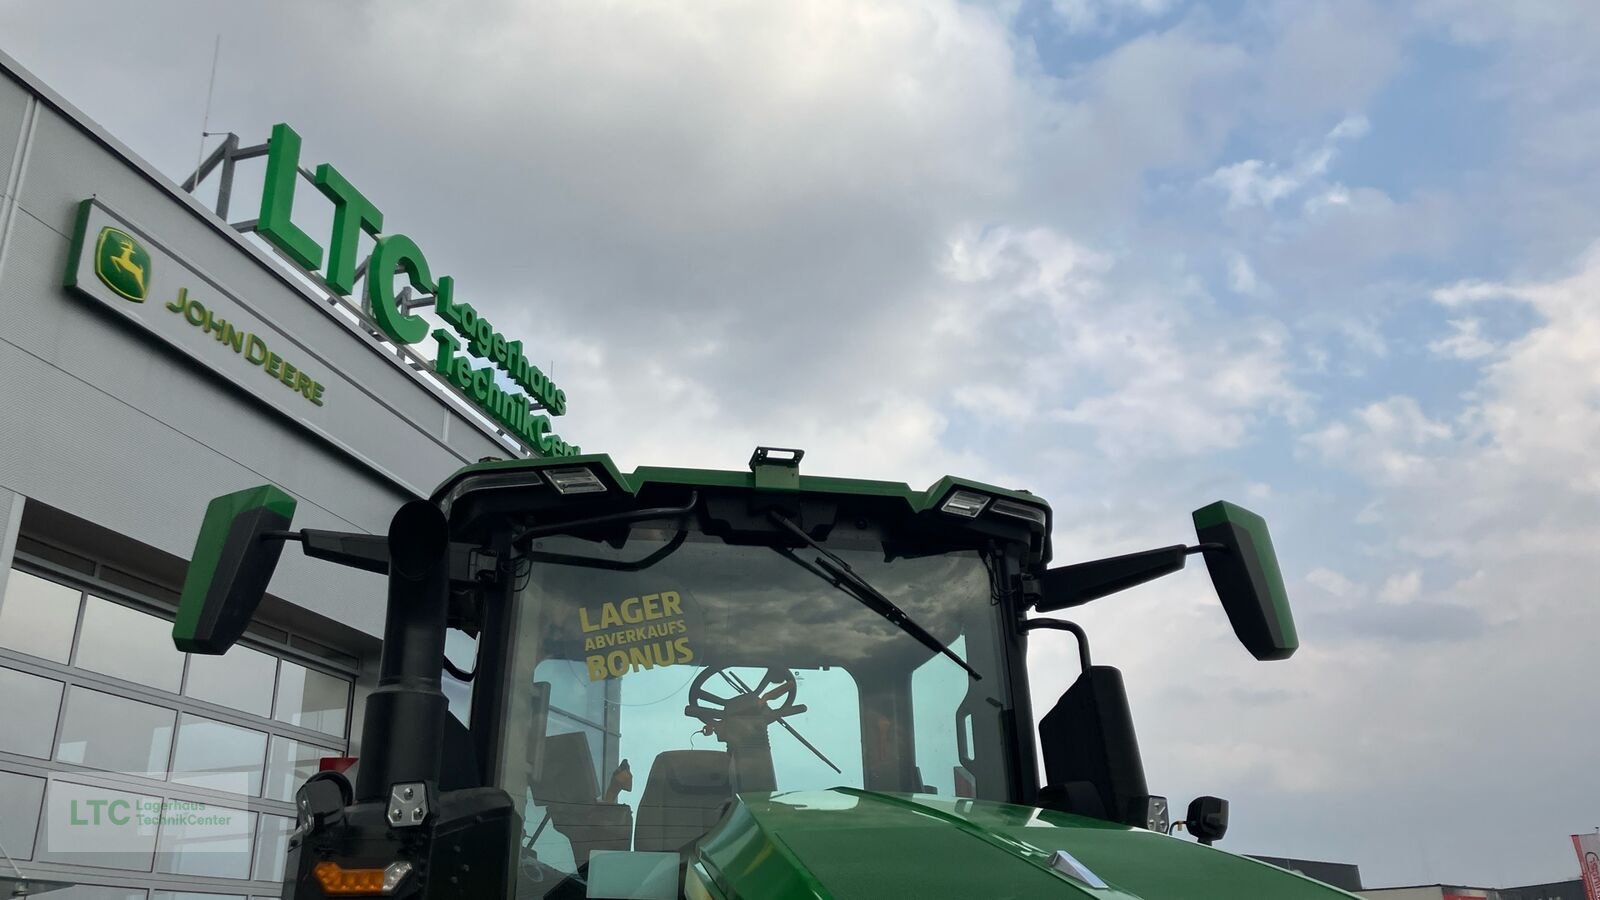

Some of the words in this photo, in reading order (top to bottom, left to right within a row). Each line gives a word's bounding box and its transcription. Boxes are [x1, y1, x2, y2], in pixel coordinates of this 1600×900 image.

[258, 122, 434, 345] LTC
[165, 287, 245, 354] JOHN
[244, 333, 326, 408] DEERE
[435, 275, 567, 416] Lagerhaus
[578, 591, 684, 633] LAGER
[584, 619, 687, 651] ABVERKAUFS
[586, 637, 694, 683] BONUS
